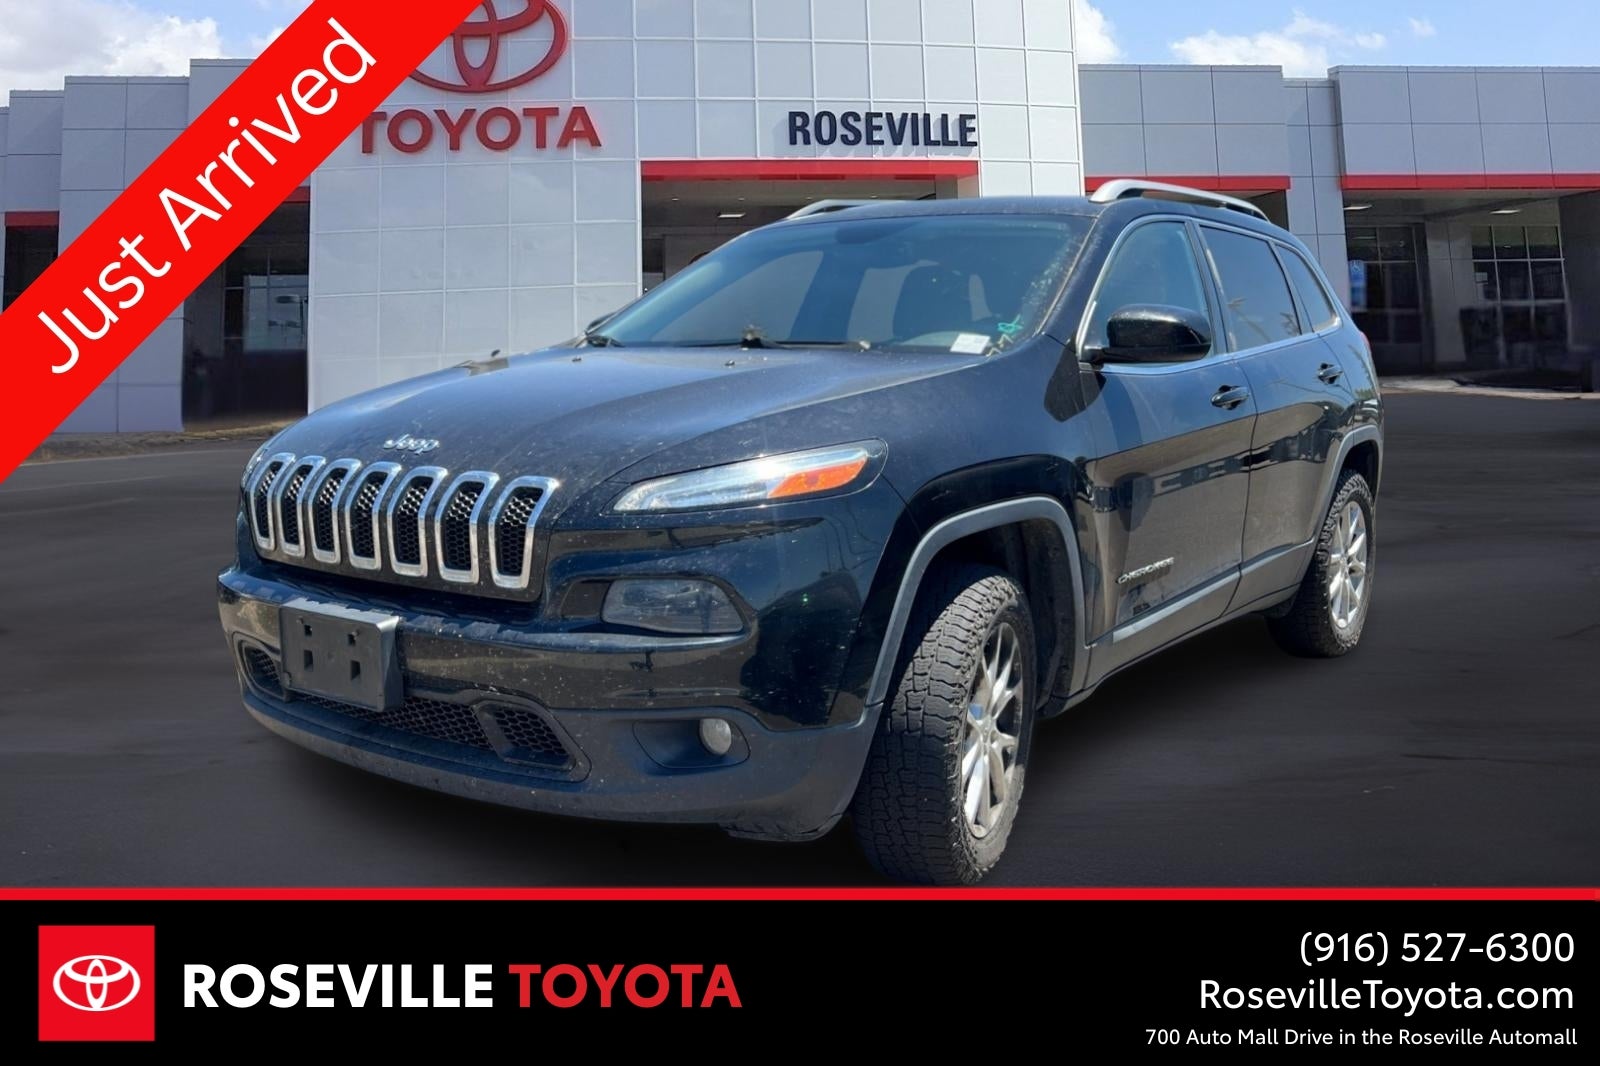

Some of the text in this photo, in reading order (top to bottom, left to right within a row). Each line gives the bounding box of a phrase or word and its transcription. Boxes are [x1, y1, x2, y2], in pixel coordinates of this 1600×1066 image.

[361, 106, 602, 154] TOYOTA
[788, 110, 978, 147] ROSEVILLE
[383, 433, 440, 454] Jeep
